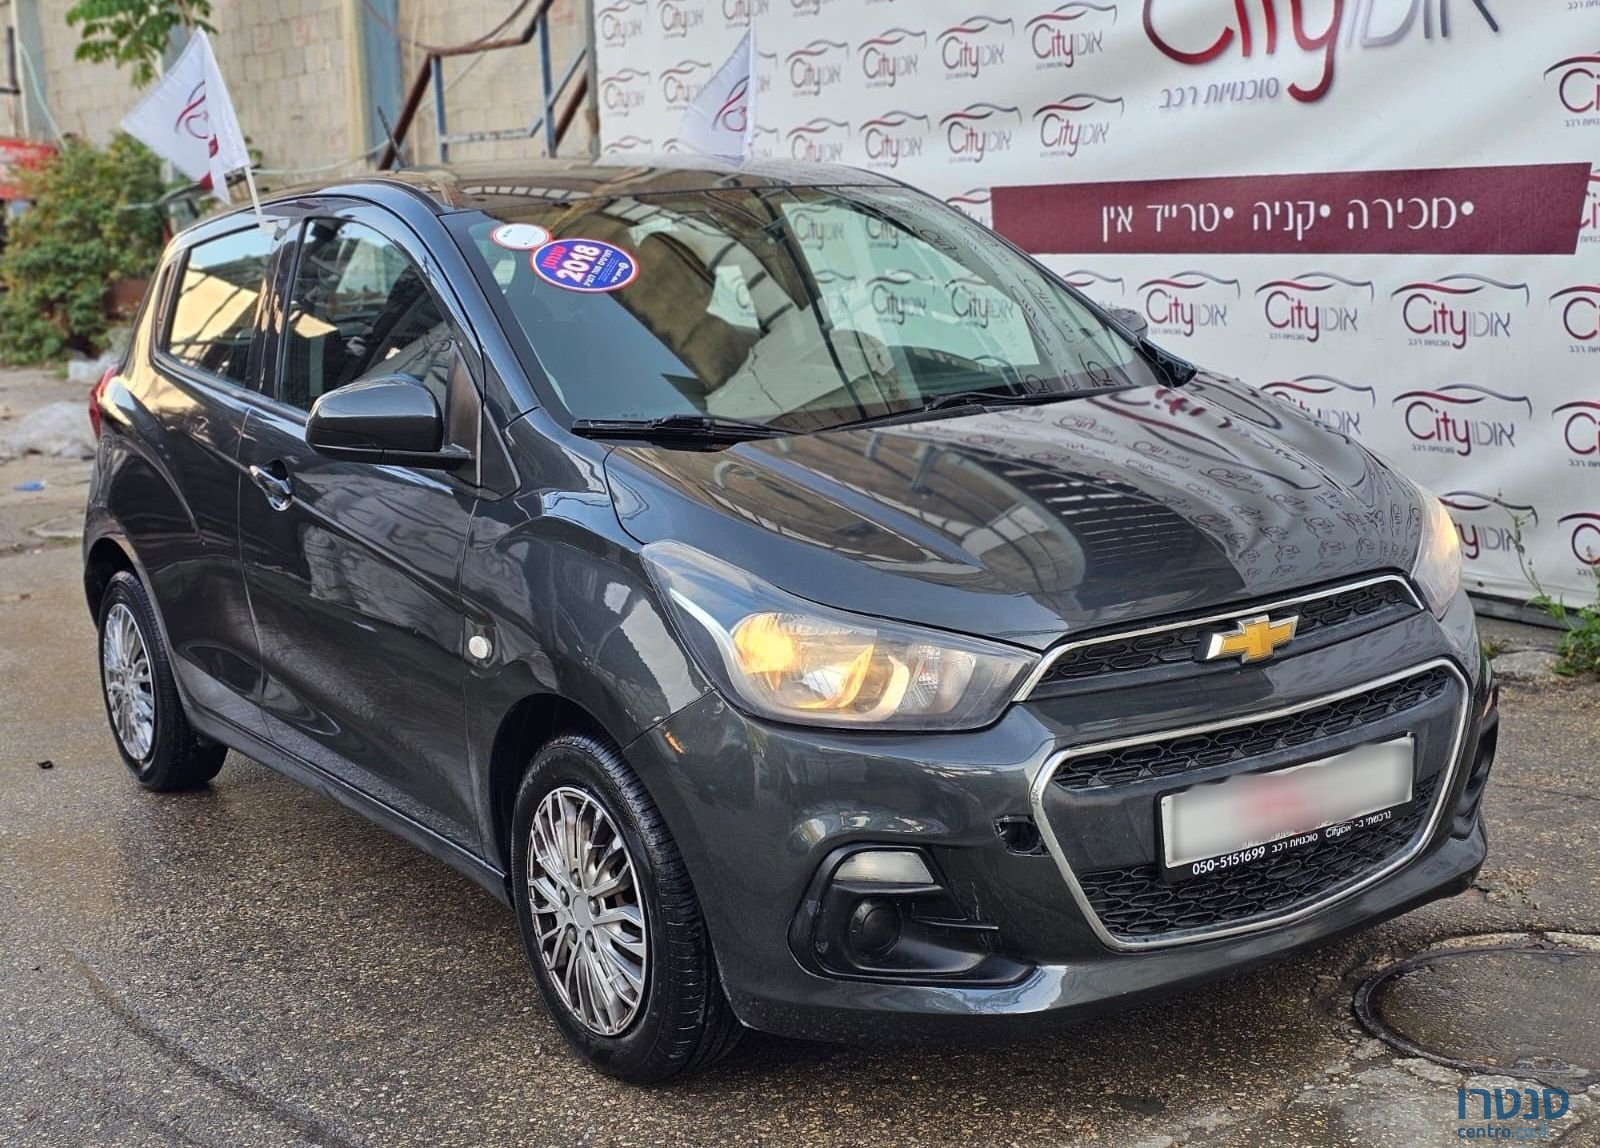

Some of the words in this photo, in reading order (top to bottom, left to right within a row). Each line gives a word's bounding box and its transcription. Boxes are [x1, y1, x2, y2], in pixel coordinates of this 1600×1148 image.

[1158, 86, 1199, 109] רכב
[1102, 205, 1134, 244] אין
[1146, 202, 1220, 233] טרייד
[1253, 200, 1316, 242] קניה
[1347, 197, 1457, 231] מכירה
[556, 245, 600, 282] 2018
[1146, 289, 1194, 337] City
[1265, 290, 1319, 343] City
[1403, 293, 1466, 349] City
[1405, 400, 1471, 457] City
[1192, 845, 1266, 876] 050-5151699
[1271, 842, 1288, 853] רכב
